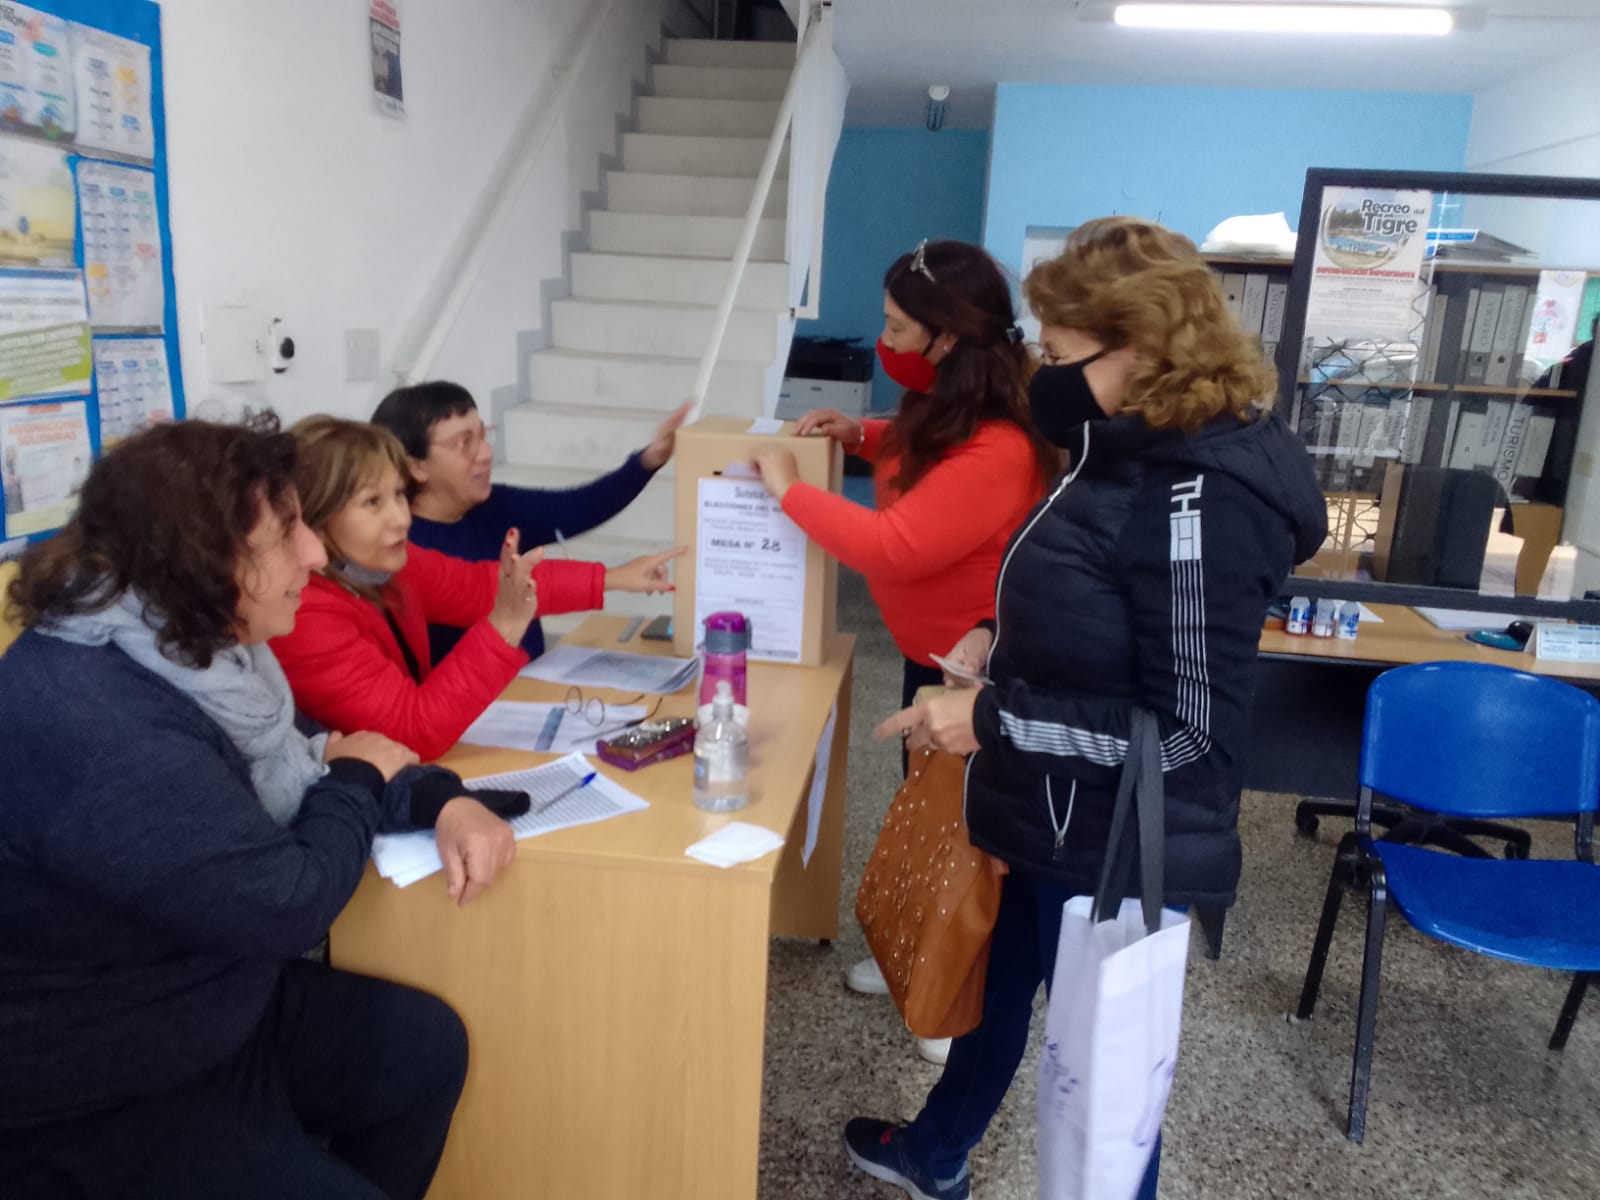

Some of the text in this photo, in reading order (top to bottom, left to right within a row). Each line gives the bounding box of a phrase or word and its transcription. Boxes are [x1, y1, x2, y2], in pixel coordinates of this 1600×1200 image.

[1362, 199, 1410, 214] Recreo
[1364, 212, 1418, 236] Tigre
[1498, 417, 1525, 481] TURISMO
[711, 537, 741, 549] MESA
